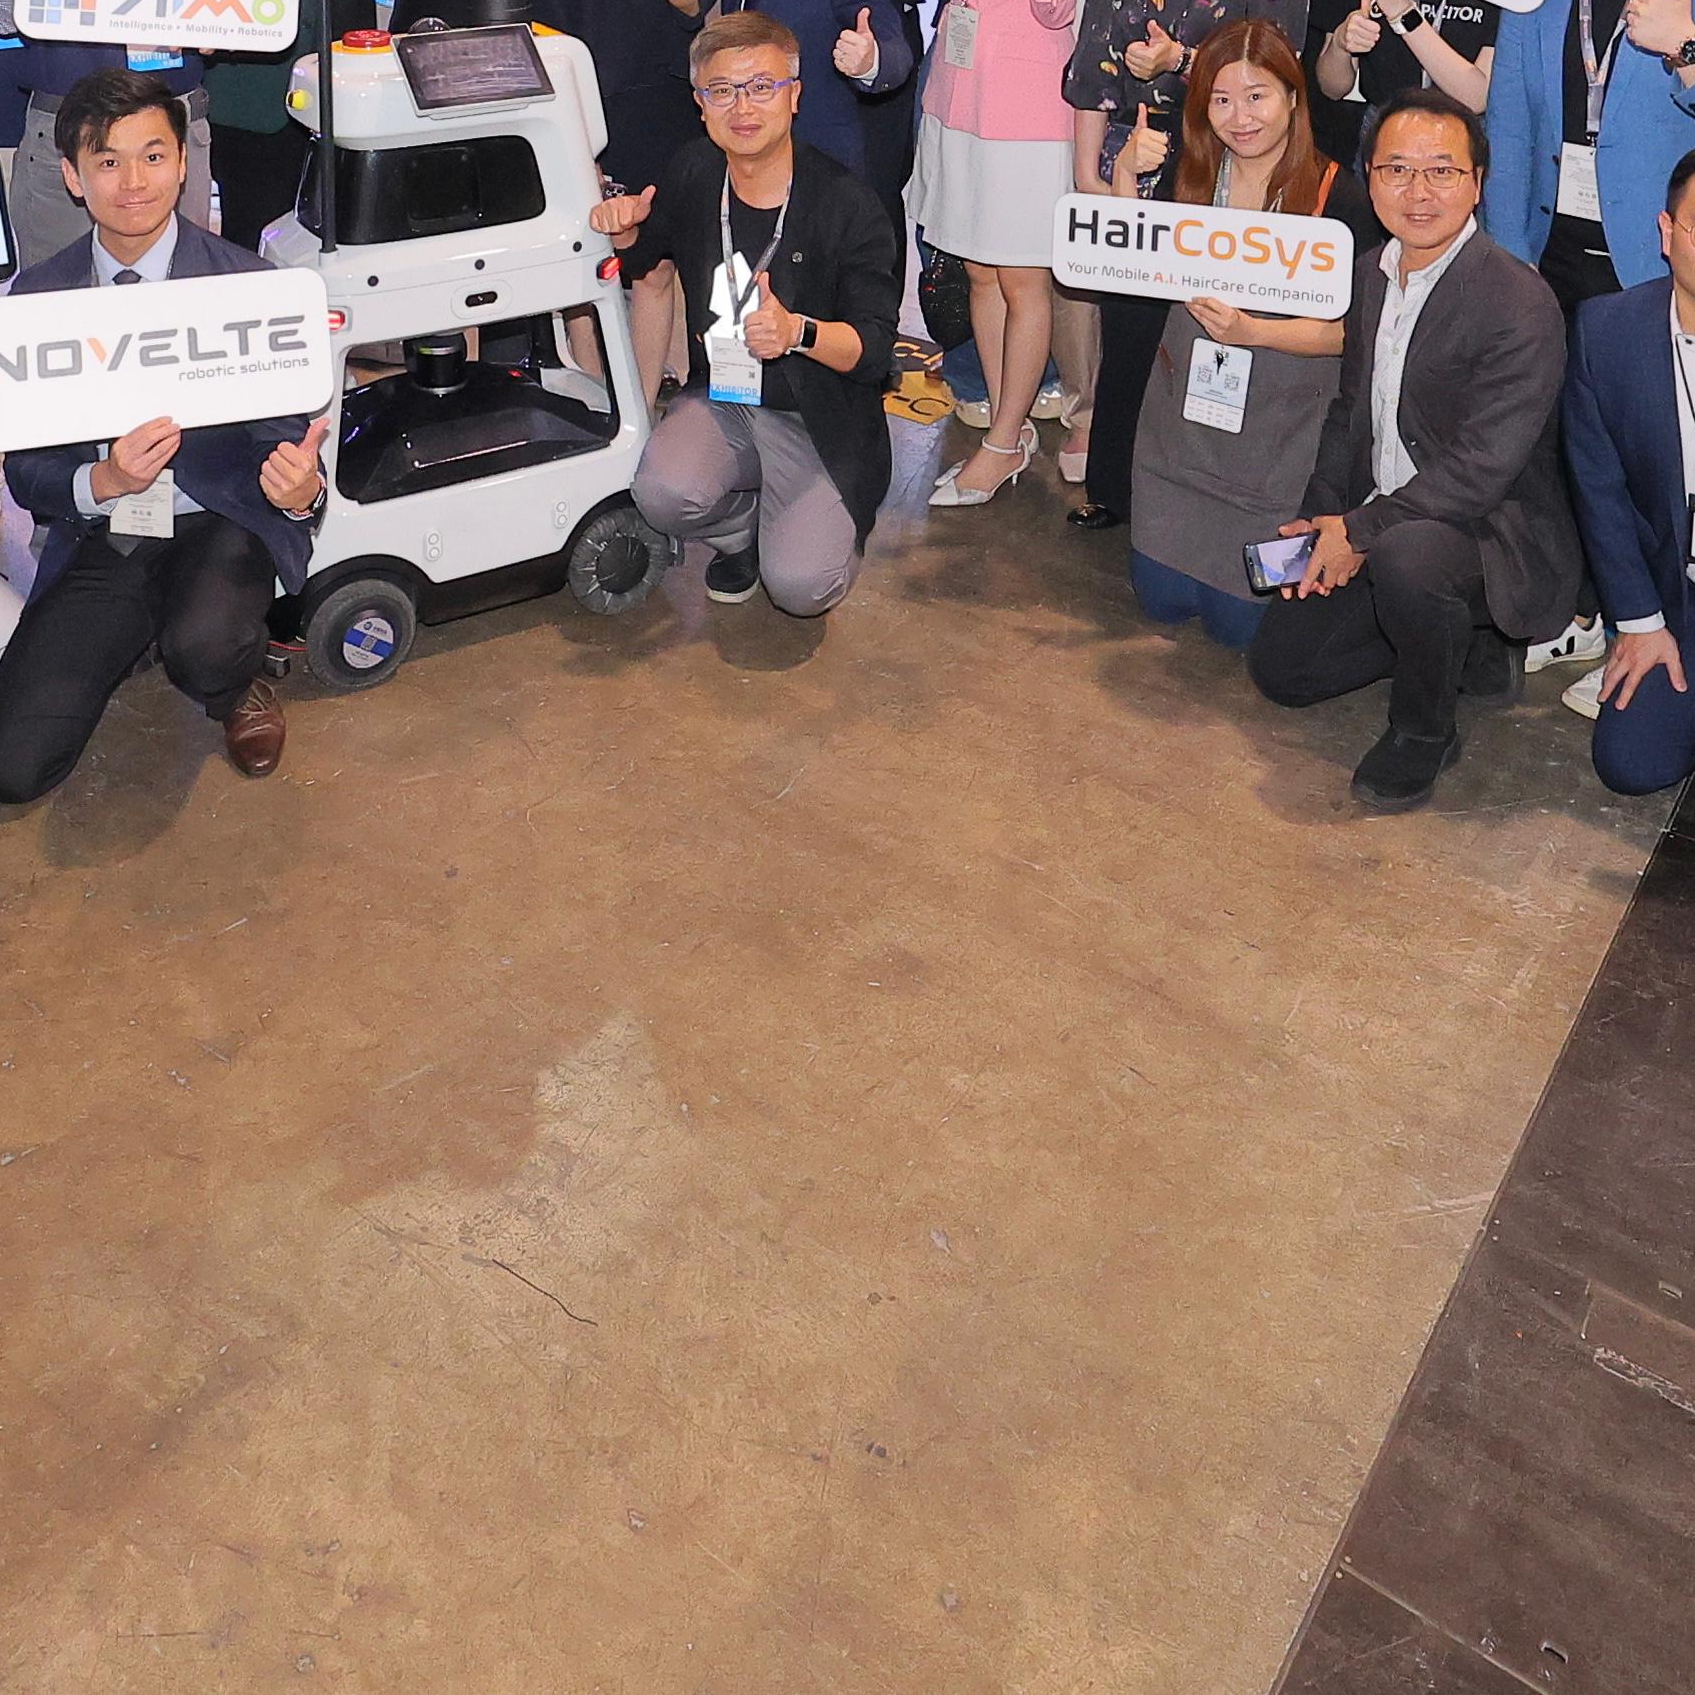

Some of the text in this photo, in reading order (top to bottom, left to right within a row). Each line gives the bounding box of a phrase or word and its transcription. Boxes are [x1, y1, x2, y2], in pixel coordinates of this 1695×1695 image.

[109, 19, 284, 39] Intelligence Mobility Robotics
[1068, 207, 1336, 280] HairCoSys
[1066, 261, 1335, 305] Your Mobile A.I. HairCare Companion
[178, 356, 311, 382] robotic solutions
